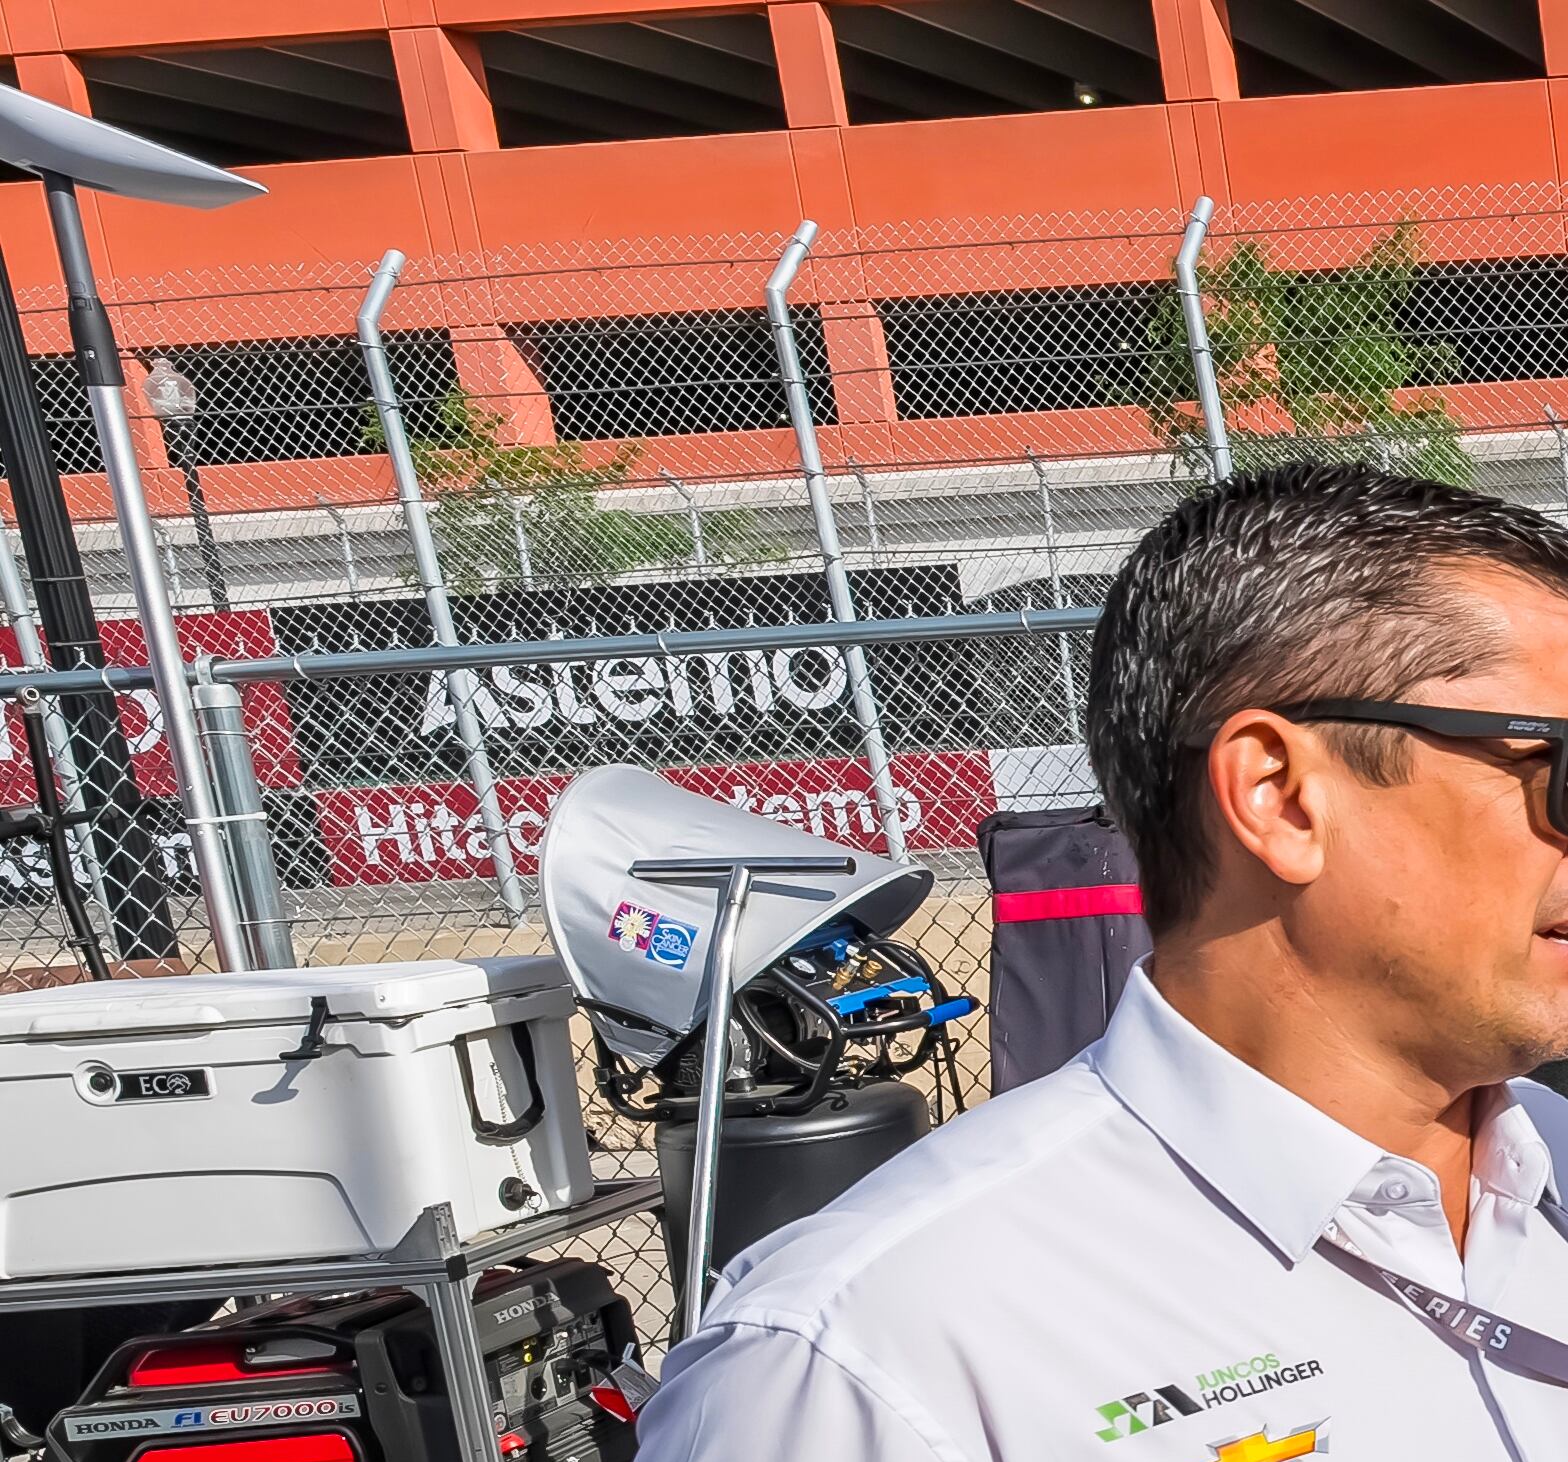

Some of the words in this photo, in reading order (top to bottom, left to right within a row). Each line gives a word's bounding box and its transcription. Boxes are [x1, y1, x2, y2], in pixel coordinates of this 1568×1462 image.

[420, 645, 848, 736] Astemo
[493, 1292, 561, 1324] HONDA
[1195, 1353, 1281, 1391] JUNCOS
[1202, 1360, 1324, 1409] HOLLINGER
[75, 1417, 161, 1434] HONDA
